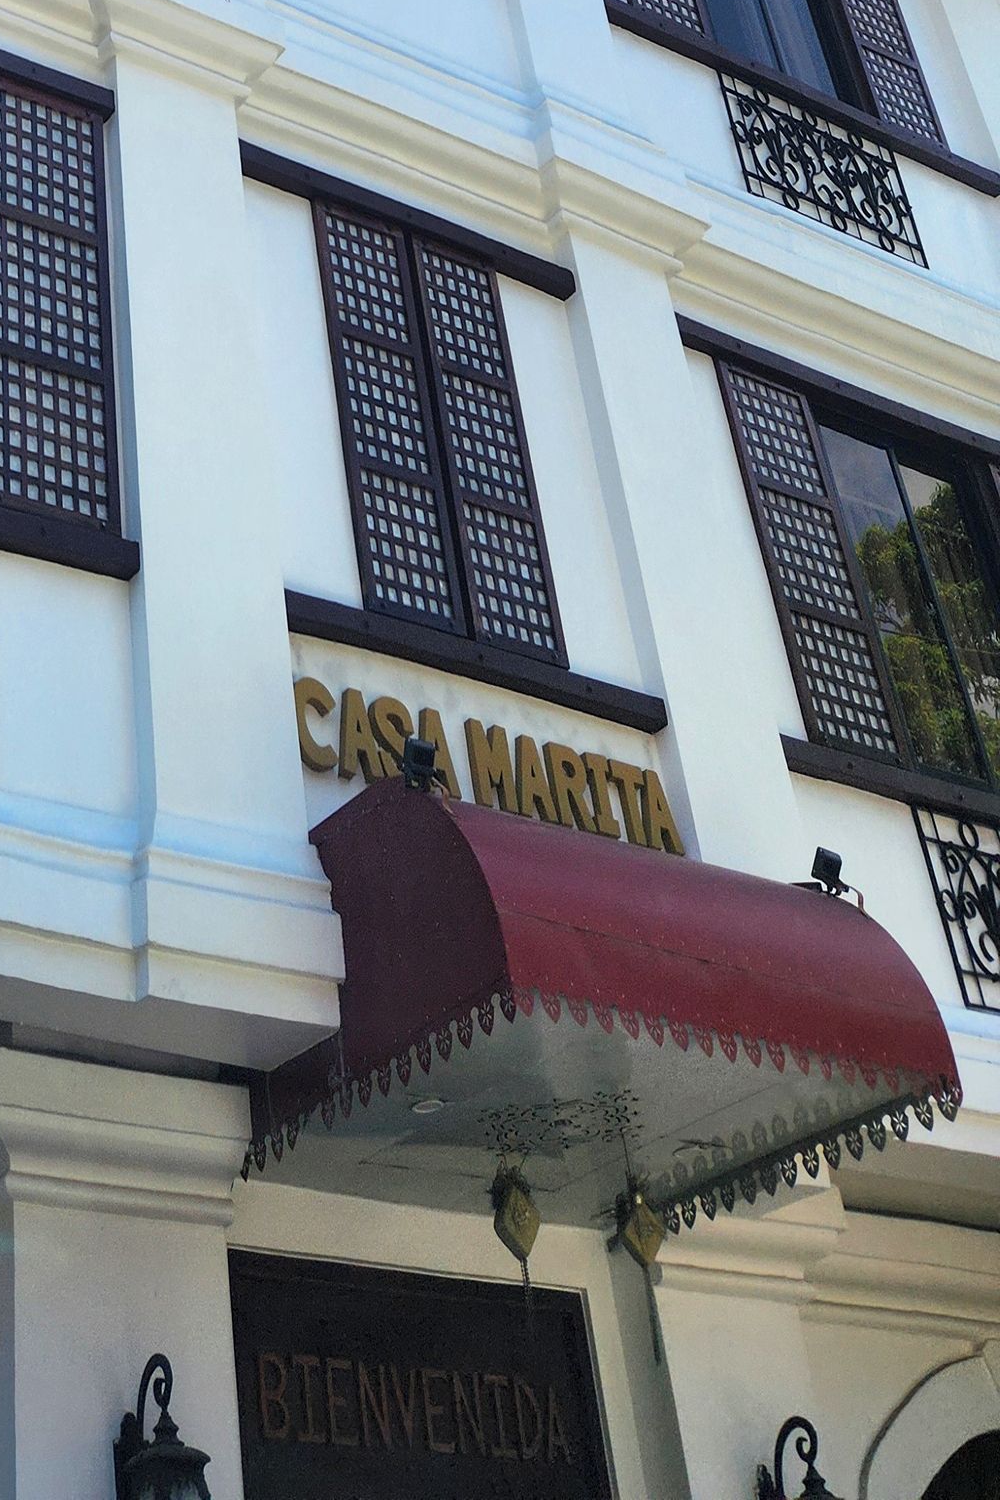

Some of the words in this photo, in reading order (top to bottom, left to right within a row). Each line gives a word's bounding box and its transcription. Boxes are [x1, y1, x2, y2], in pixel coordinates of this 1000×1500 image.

[293, 676, 462, 800] CASA
[464, 718, 686, 856] MARITA
[257, 1350, 574, 1465] BIENVENIDA
